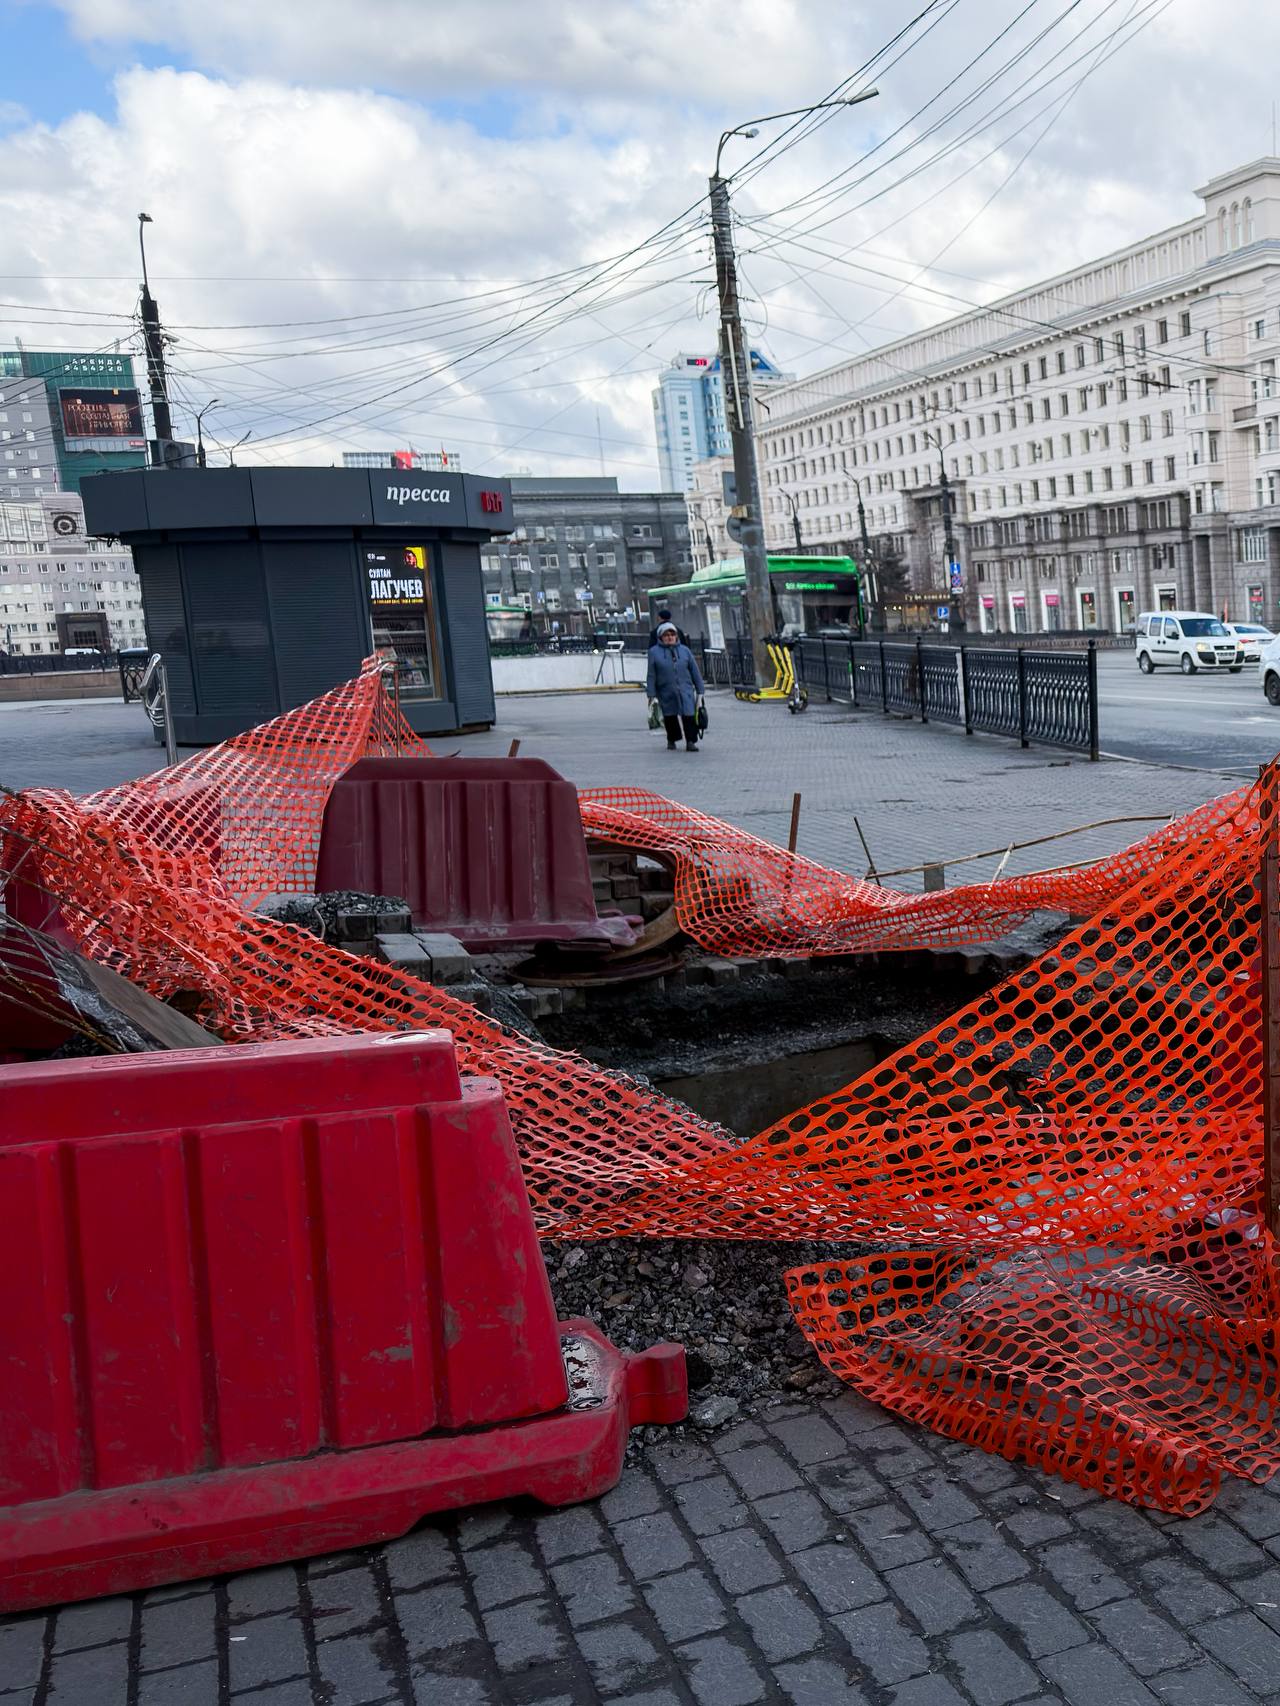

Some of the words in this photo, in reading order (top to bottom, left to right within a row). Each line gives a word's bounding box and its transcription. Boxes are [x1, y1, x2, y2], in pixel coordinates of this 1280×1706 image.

[386, 486, 450, 505] пресса
[368, 568, 392, 579] СУЛТАН
[371, 579, 424, 599] ЛАГУЧЕВ
